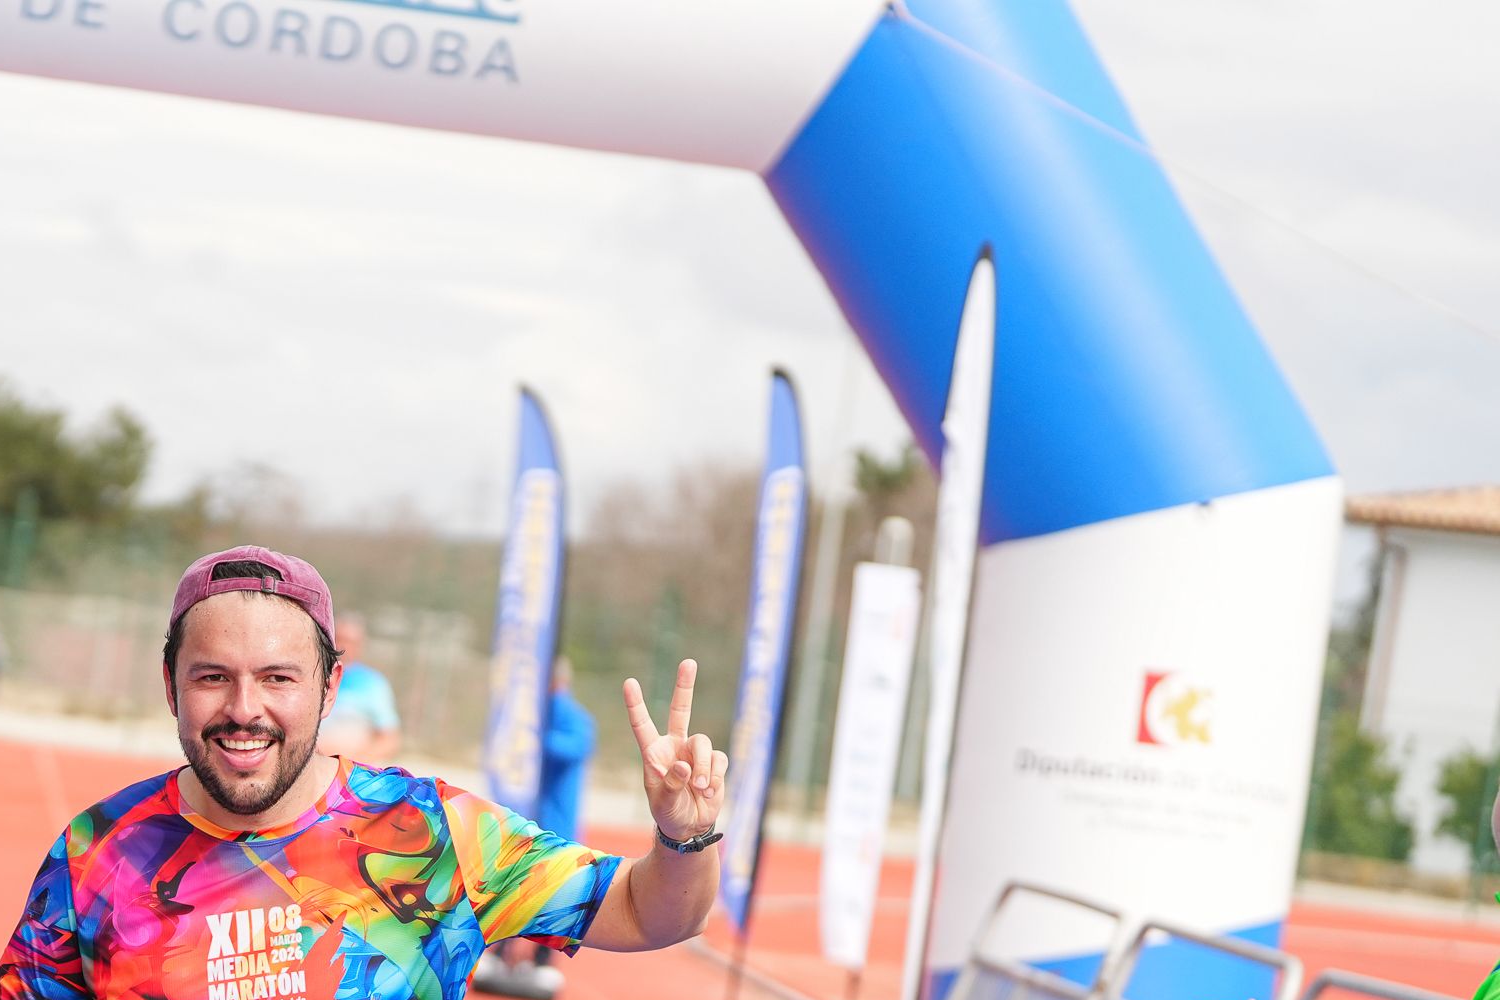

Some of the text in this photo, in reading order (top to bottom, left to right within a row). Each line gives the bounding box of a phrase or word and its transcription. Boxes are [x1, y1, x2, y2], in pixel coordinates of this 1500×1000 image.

[268, 904, 302, 933] 08
[205, 908, 266, 960] XII
[270, 932, 303, 947] MARZO
[206, 952, 271, 983] MEDIA
[271, 945, 304, 964] 2026
